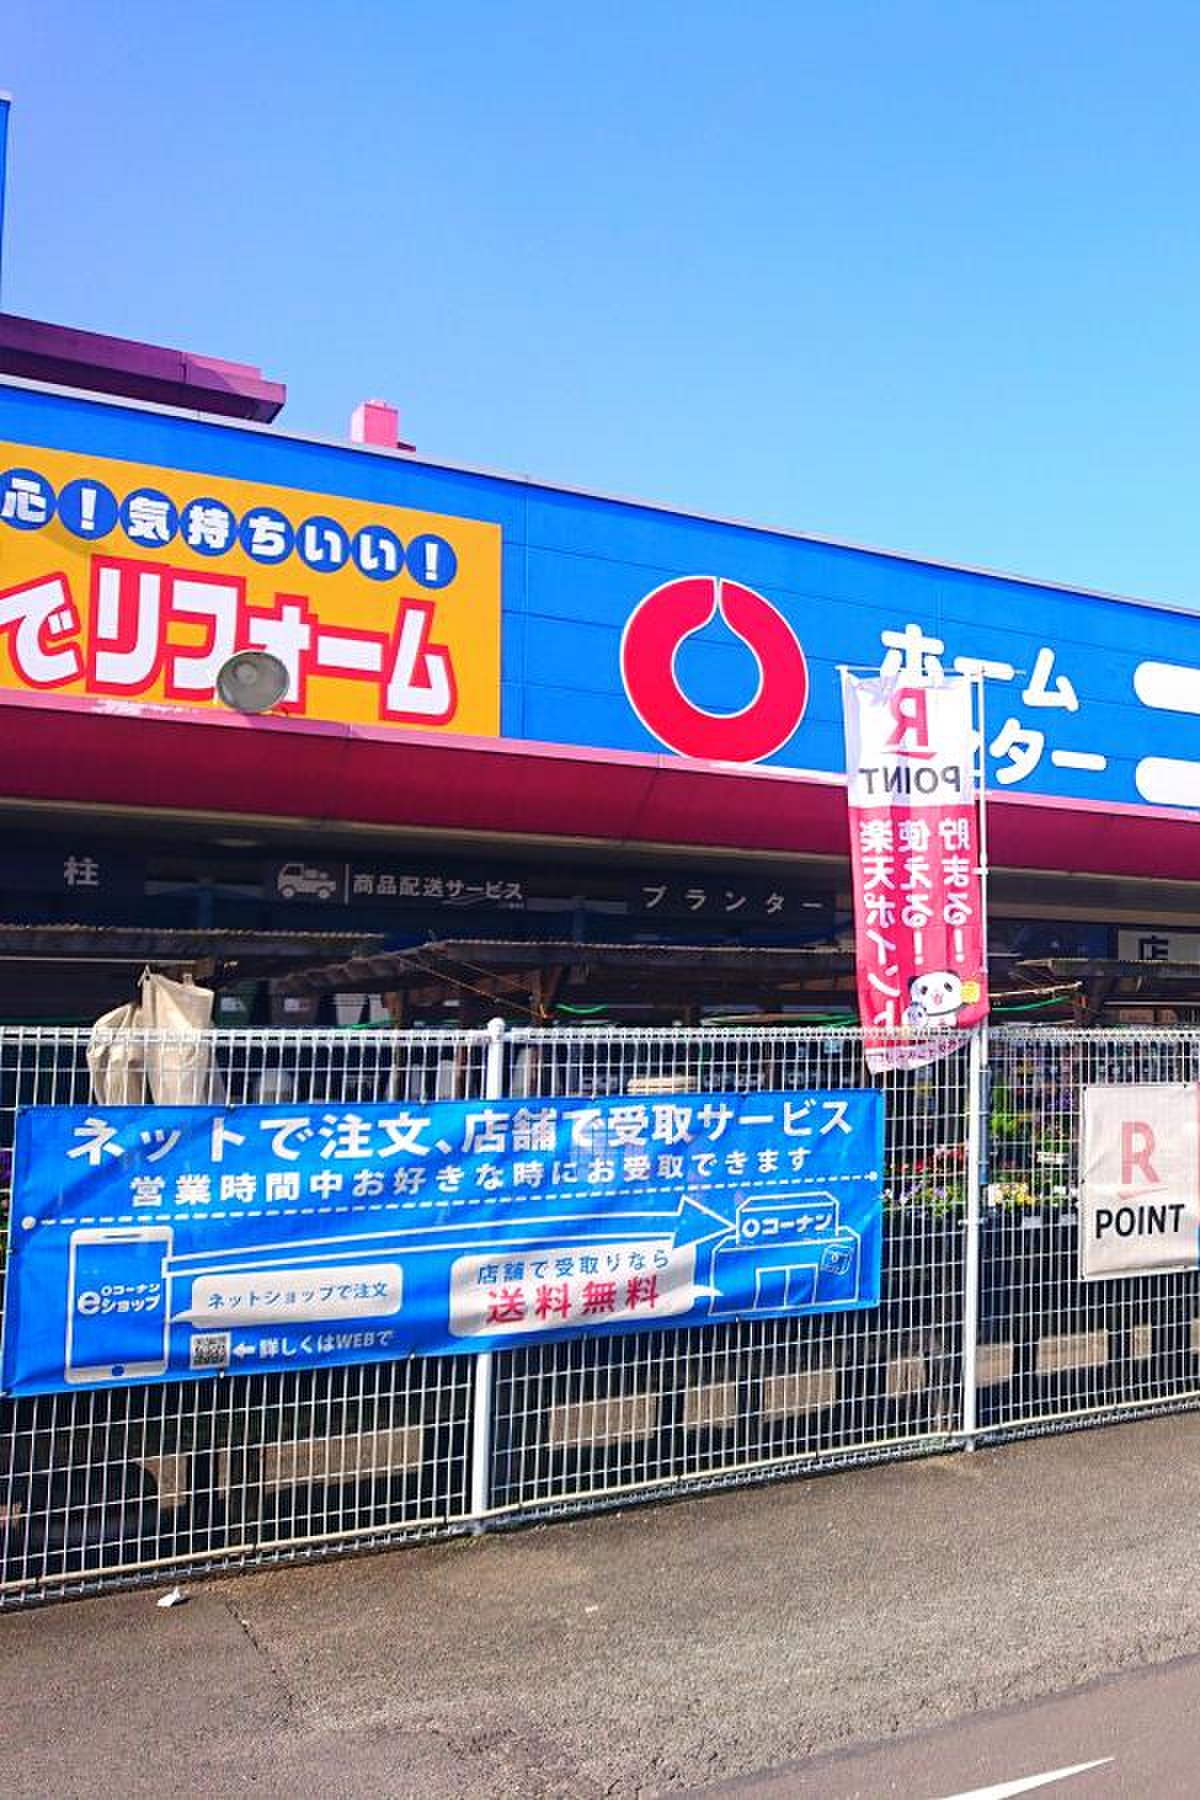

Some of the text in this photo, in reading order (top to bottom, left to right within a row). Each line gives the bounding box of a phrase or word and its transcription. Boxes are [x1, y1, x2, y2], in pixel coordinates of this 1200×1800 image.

[63, 856, 100, 886] 柱
[352, 873, 523, 899] 商品配送サービス
[67, 1098, 853, 1166] ネットで注文、店舗で受取サービス
[129, 1146, 813, 1207] 営業時間中お好きな時にお受取できます
[762, 1214, 833, 1235] コーナン
[1095, 1203, 1185, 1239] POINT
[477, 1248, 671, 1285] 店舗で受取りなら
[207, 1280, 389, 1310] ネットショップで注文
[485, 1274, 660, 1325] 送料無料
